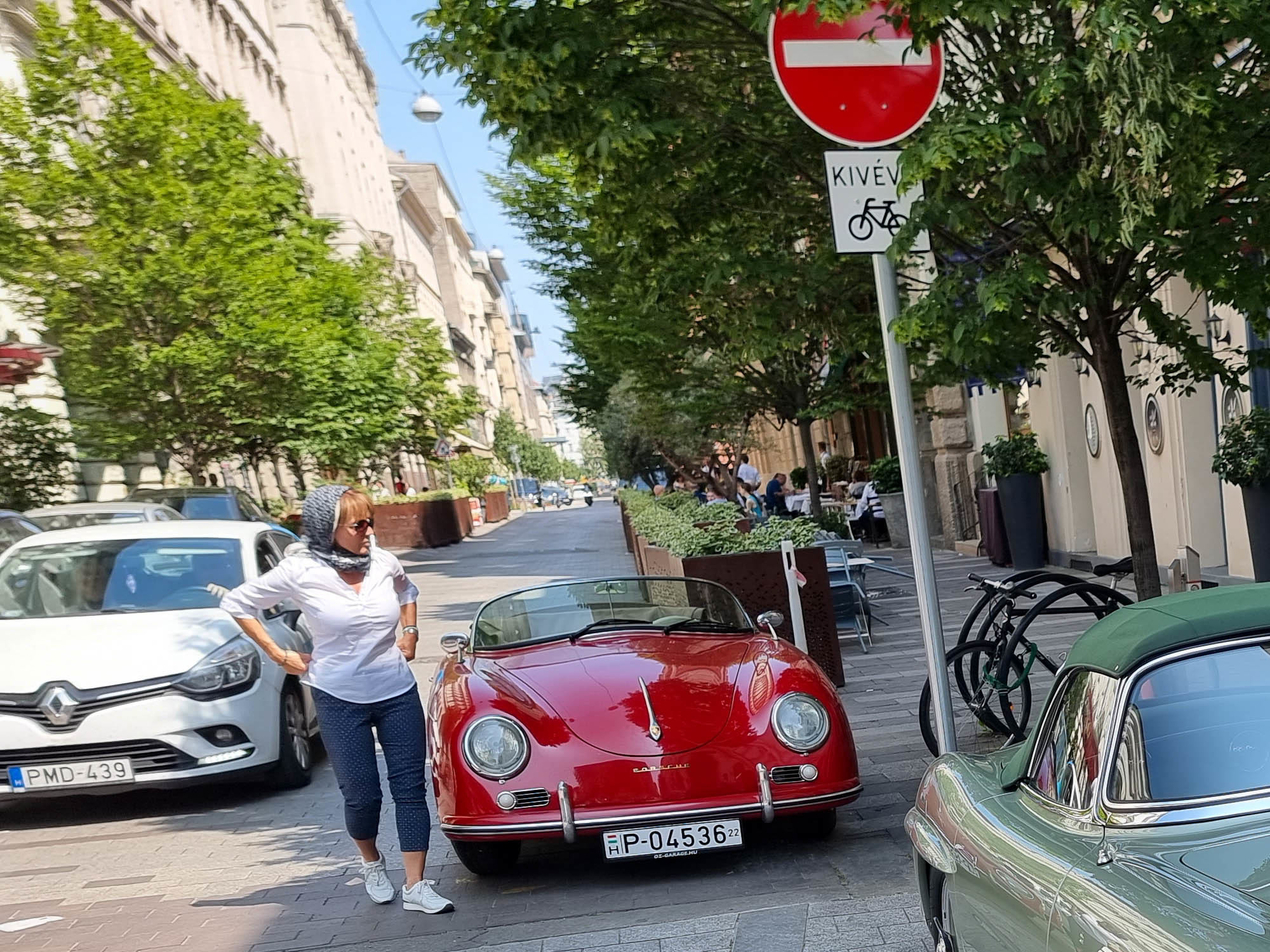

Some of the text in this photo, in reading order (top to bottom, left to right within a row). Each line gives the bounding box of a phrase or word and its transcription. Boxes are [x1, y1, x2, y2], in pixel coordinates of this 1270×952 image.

[832, 159, 900, 187] KIVÉV
[26, 762, 126, 786] PMD-439
[608, 845, 620, 855] H
[623, 824, 727, 854] P-04536
